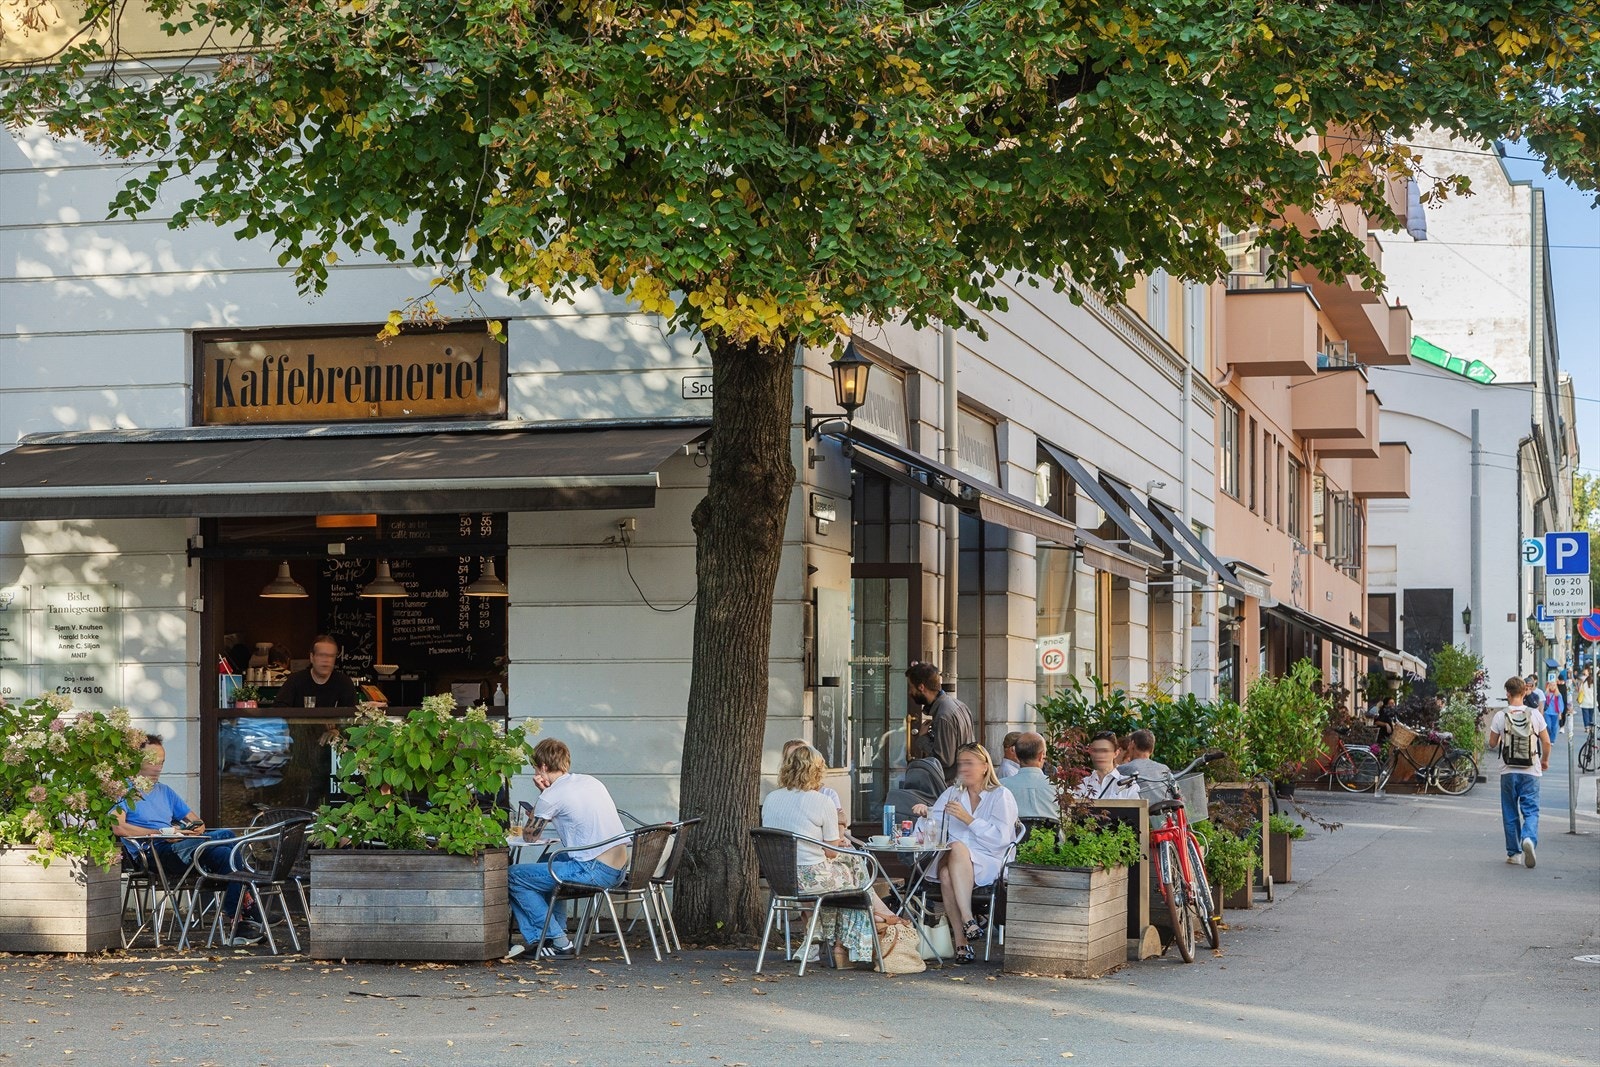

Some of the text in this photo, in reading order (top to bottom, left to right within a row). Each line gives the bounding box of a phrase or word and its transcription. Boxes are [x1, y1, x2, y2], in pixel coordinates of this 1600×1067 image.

[214, 346, 489, 409] Kaffebrenneriet
[480, 526, 492, 536] 59
[1556, 538, 1579, 570] P
[67, 592, 90, 601] Bislet
[48, 604, 110, 615] Tannlegesenter
[54, 624, 72, 632] Bjørn
[83, 643, 101, 651] Siljan
[62, 686, 103, 694] 22 45 43 00
